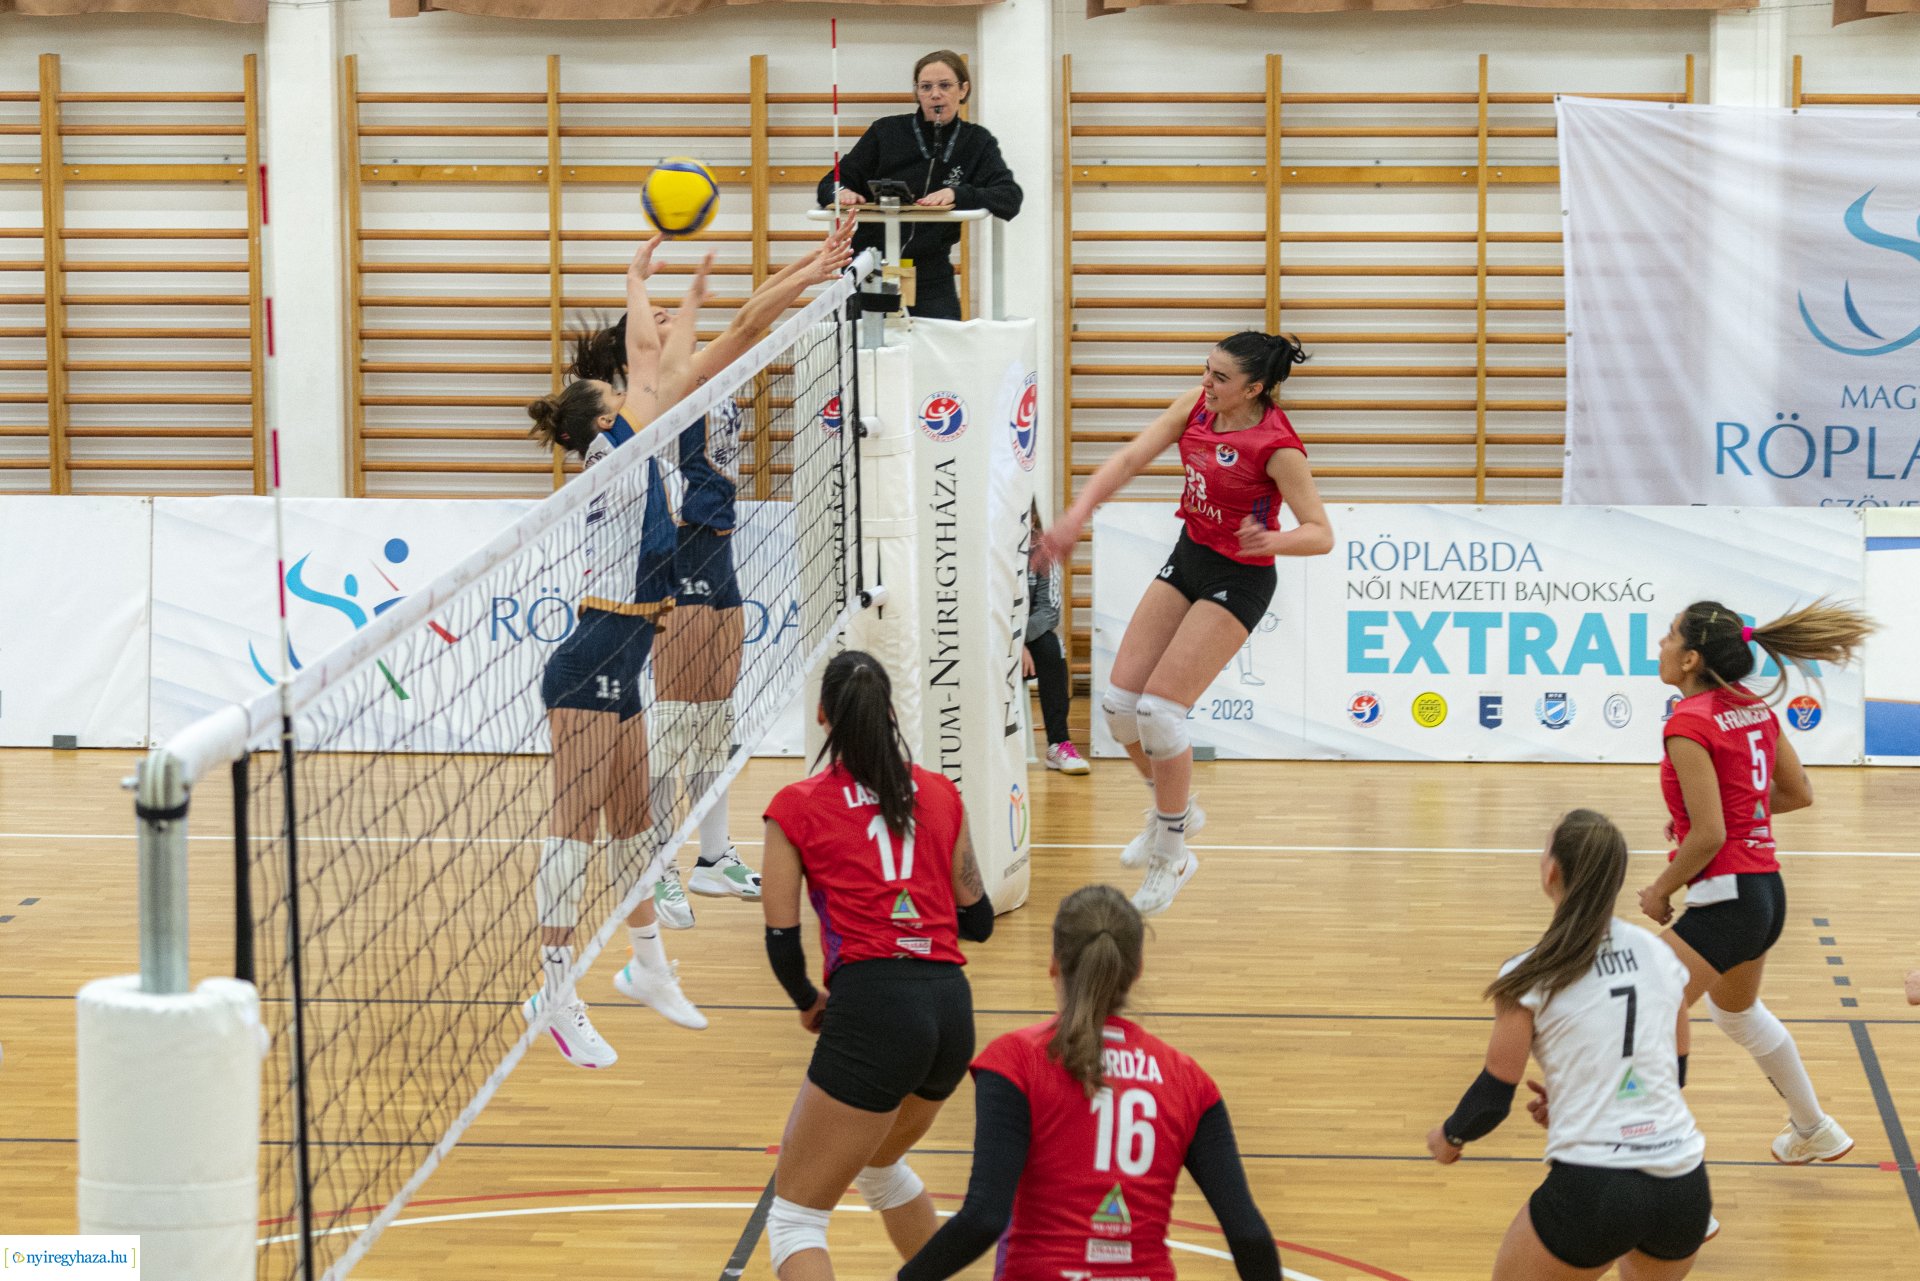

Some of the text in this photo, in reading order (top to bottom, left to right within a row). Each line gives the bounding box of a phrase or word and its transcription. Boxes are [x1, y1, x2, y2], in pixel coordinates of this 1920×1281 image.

[1841, 384, 1920, 409] MAG
[1347, 534, 1544, 572] RÖPLABDA
[1347, 576, 1655, 606] NŐI NEMZETI BAJNOKSÁG
[1347, 611, 1823, 677] EXTRAL
[1212, 699, 1254, 720] 2023
[1746, 729, 1767, 791] 5
[1610, 985, 1637, 1058] 7
[1090, 1086, 1157, 1176] 16
